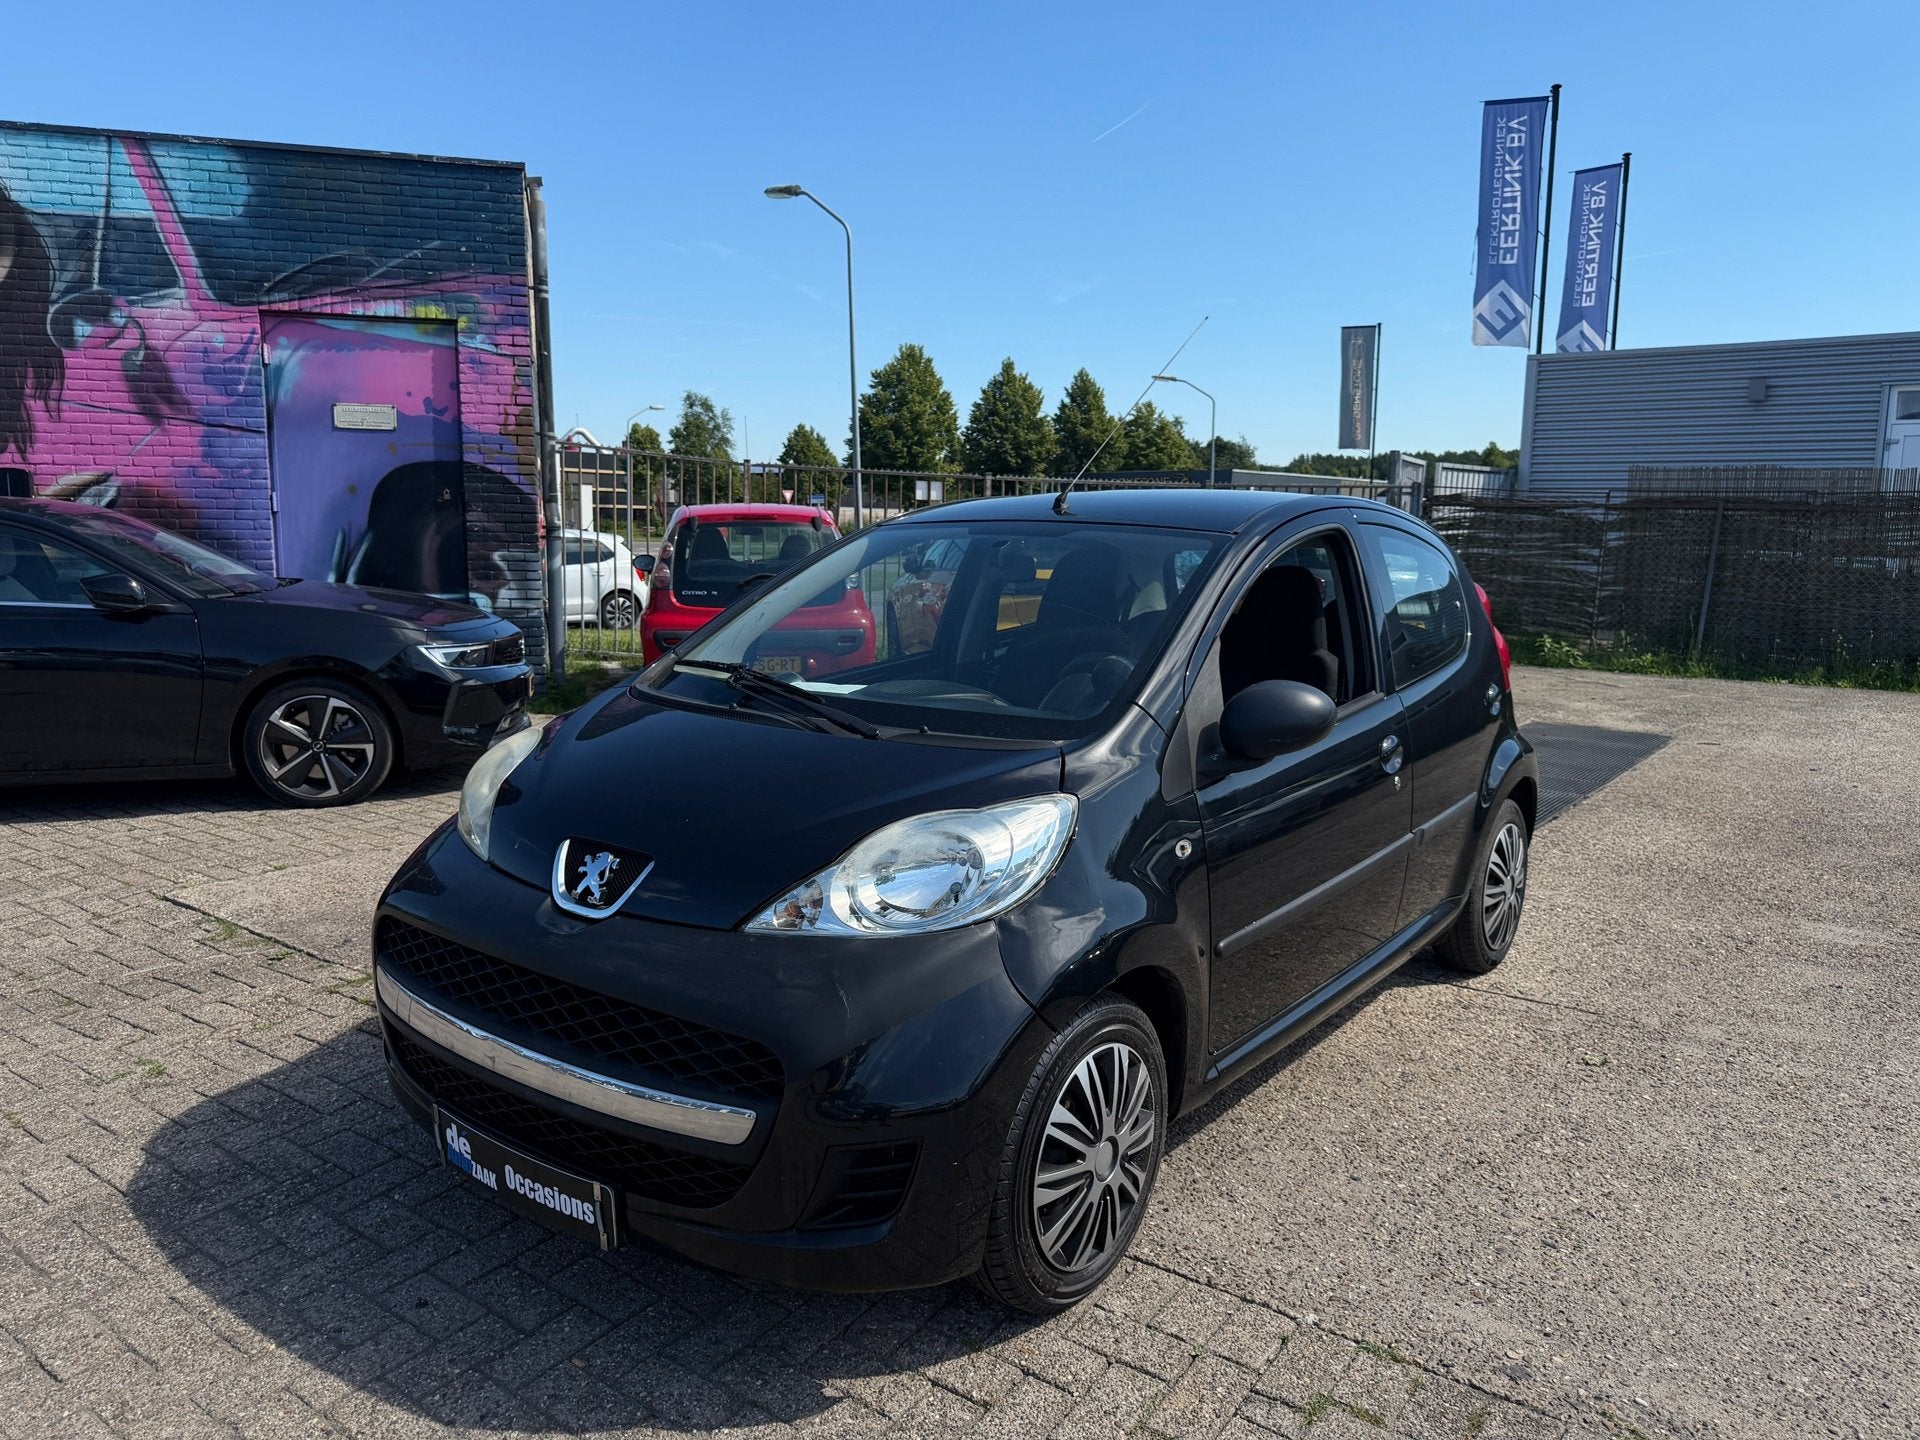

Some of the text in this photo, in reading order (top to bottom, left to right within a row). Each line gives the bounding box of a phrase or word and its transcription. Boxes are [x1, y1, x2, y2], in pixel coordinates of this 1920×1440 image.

[445, 1122, 472, 1161] de
[471, 1160, 498, 1191] ZAAK
[504, 1164, 595, 1225] Occasions
